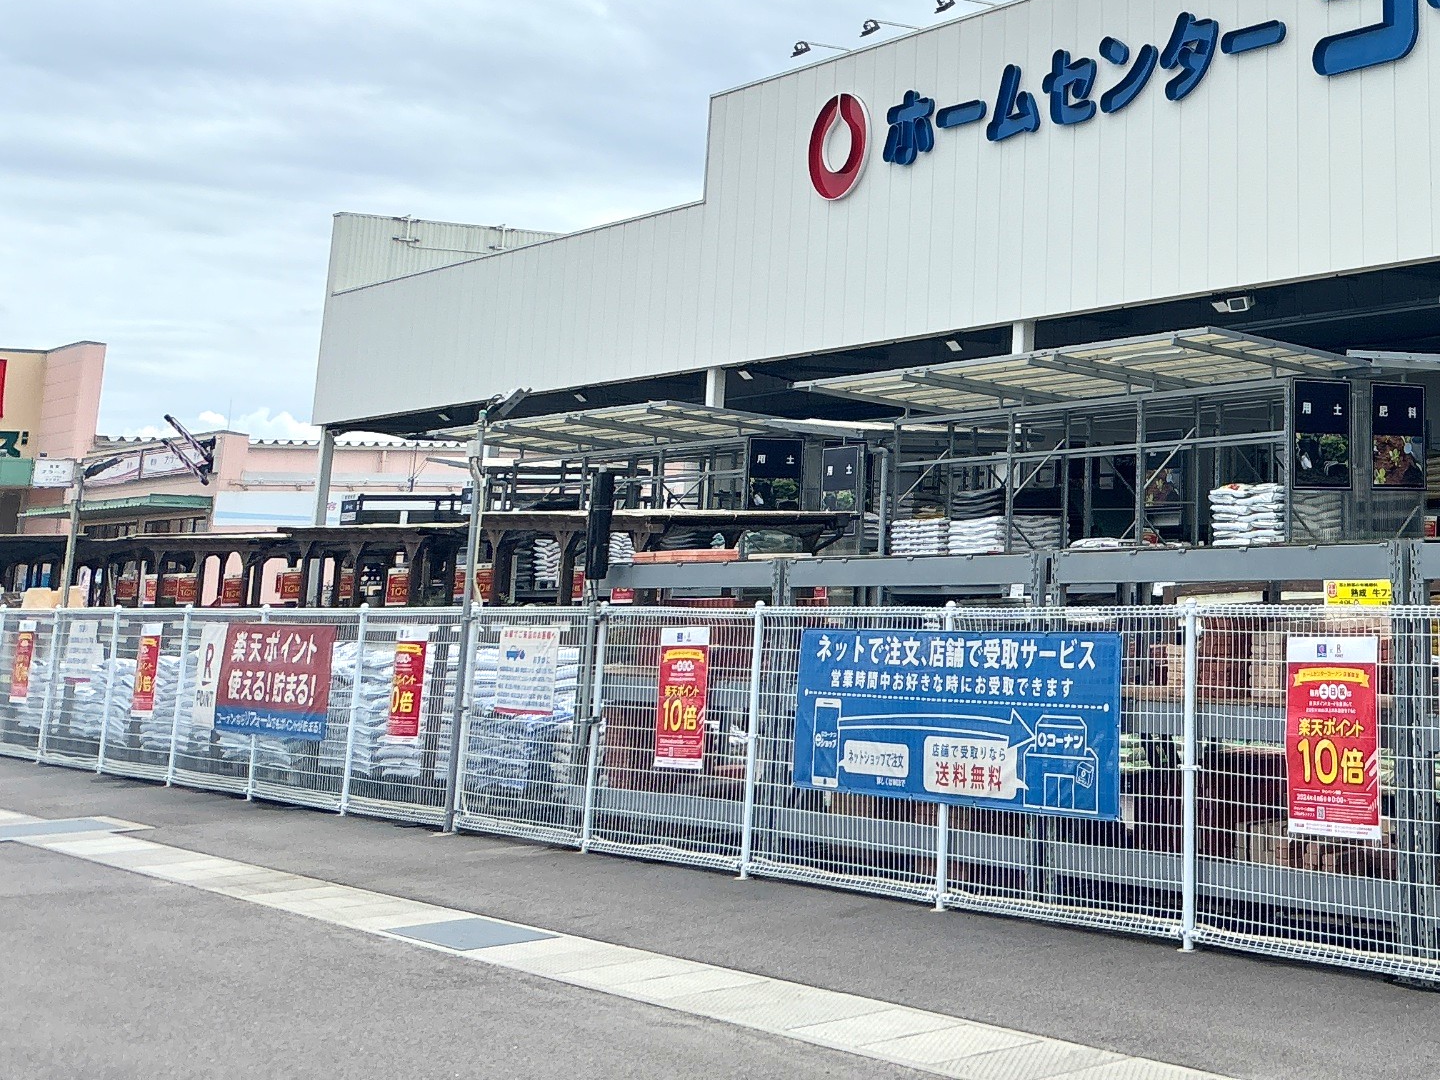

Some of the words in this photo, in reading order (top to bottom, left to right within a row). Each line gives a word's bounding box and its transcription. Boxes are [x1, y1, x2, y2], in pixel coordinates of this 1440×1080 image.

[882, 10, 1287, 166] ホームセンター
[1378, 405, 1417, 419] 肥料
[231, 630, 317, 665] 楽天ポイント
[816, 634, 1096, 670] ネットで注文、店舗で受取サービス
[227, 669, 317, 707] 使える!貯まる!
[664, 683, 700, 698] 楽天ポイント
[830, 669, 1074, 698] 営業時間中お好きな時にお受取できます
[663, 698, 698, 732] 10倍
[1297, 717, 1365, 738] 楽天ポイント
[931, 744, 1006, 760] 店舗で受取りなら
[1047, 733, 1084, 749] コーナン
[848, 749, 904, 769] ネットショップで注文
[1297, 738, 1365, 785] 10倍
[935, 761, 1002, 790] 送料無料
